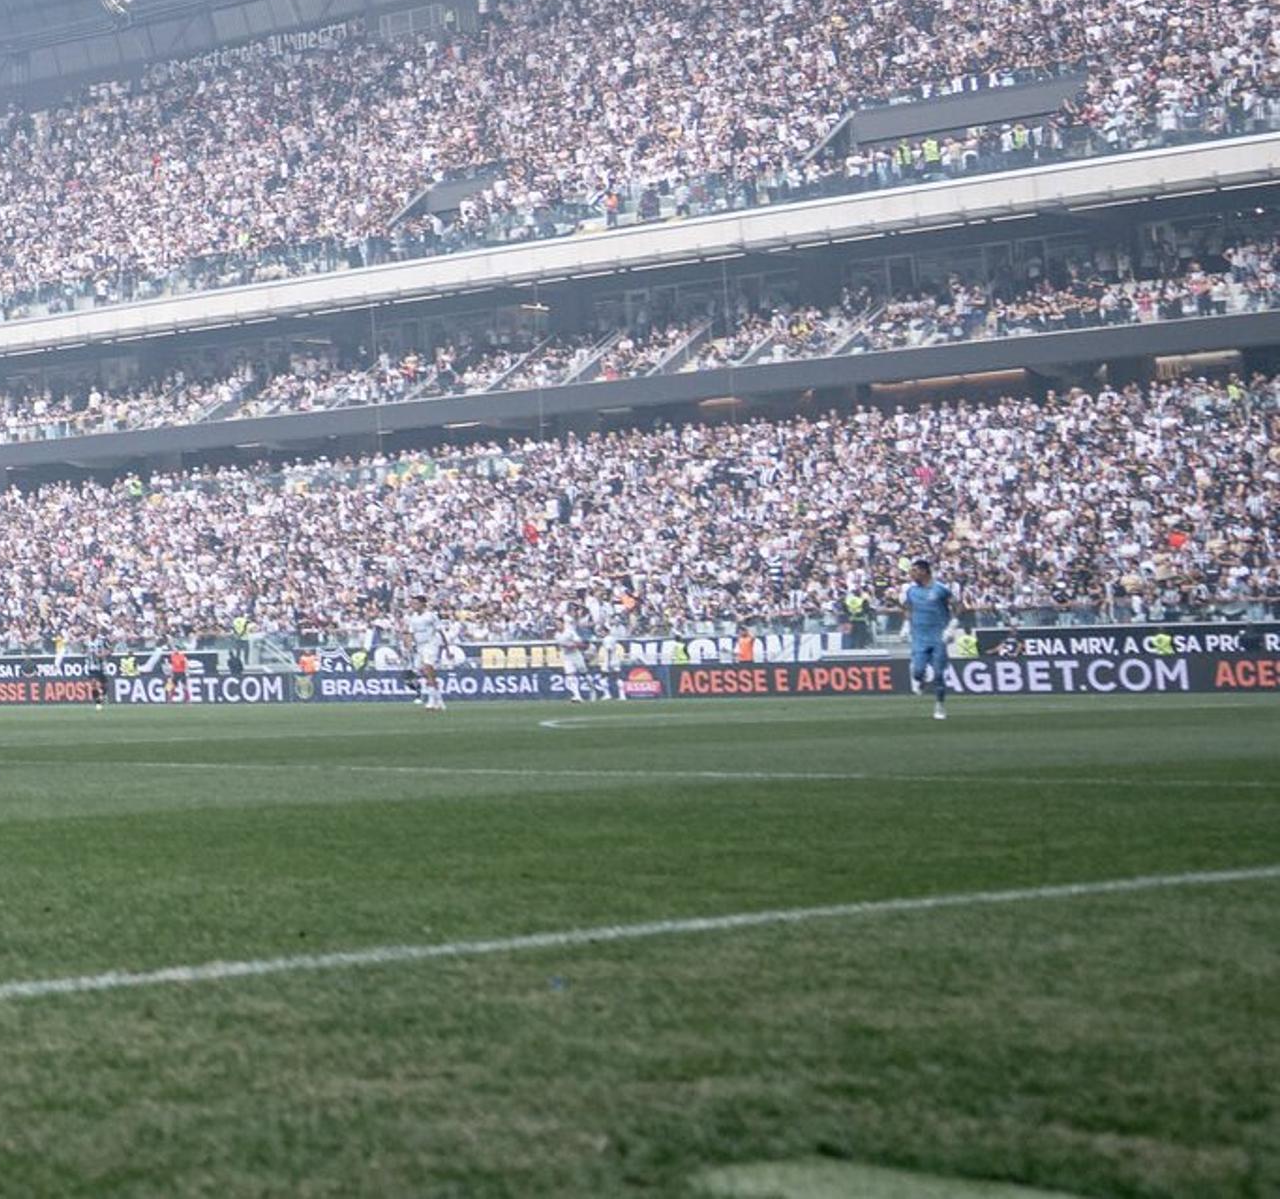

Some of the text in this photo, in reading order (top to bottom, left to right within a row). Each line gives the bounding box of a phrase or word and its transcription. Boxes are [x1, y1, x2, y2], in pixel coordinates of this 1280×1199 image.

[678, 666, 893, 693] ACESSE E APOSTE
[31, 682, 40, 701] E
